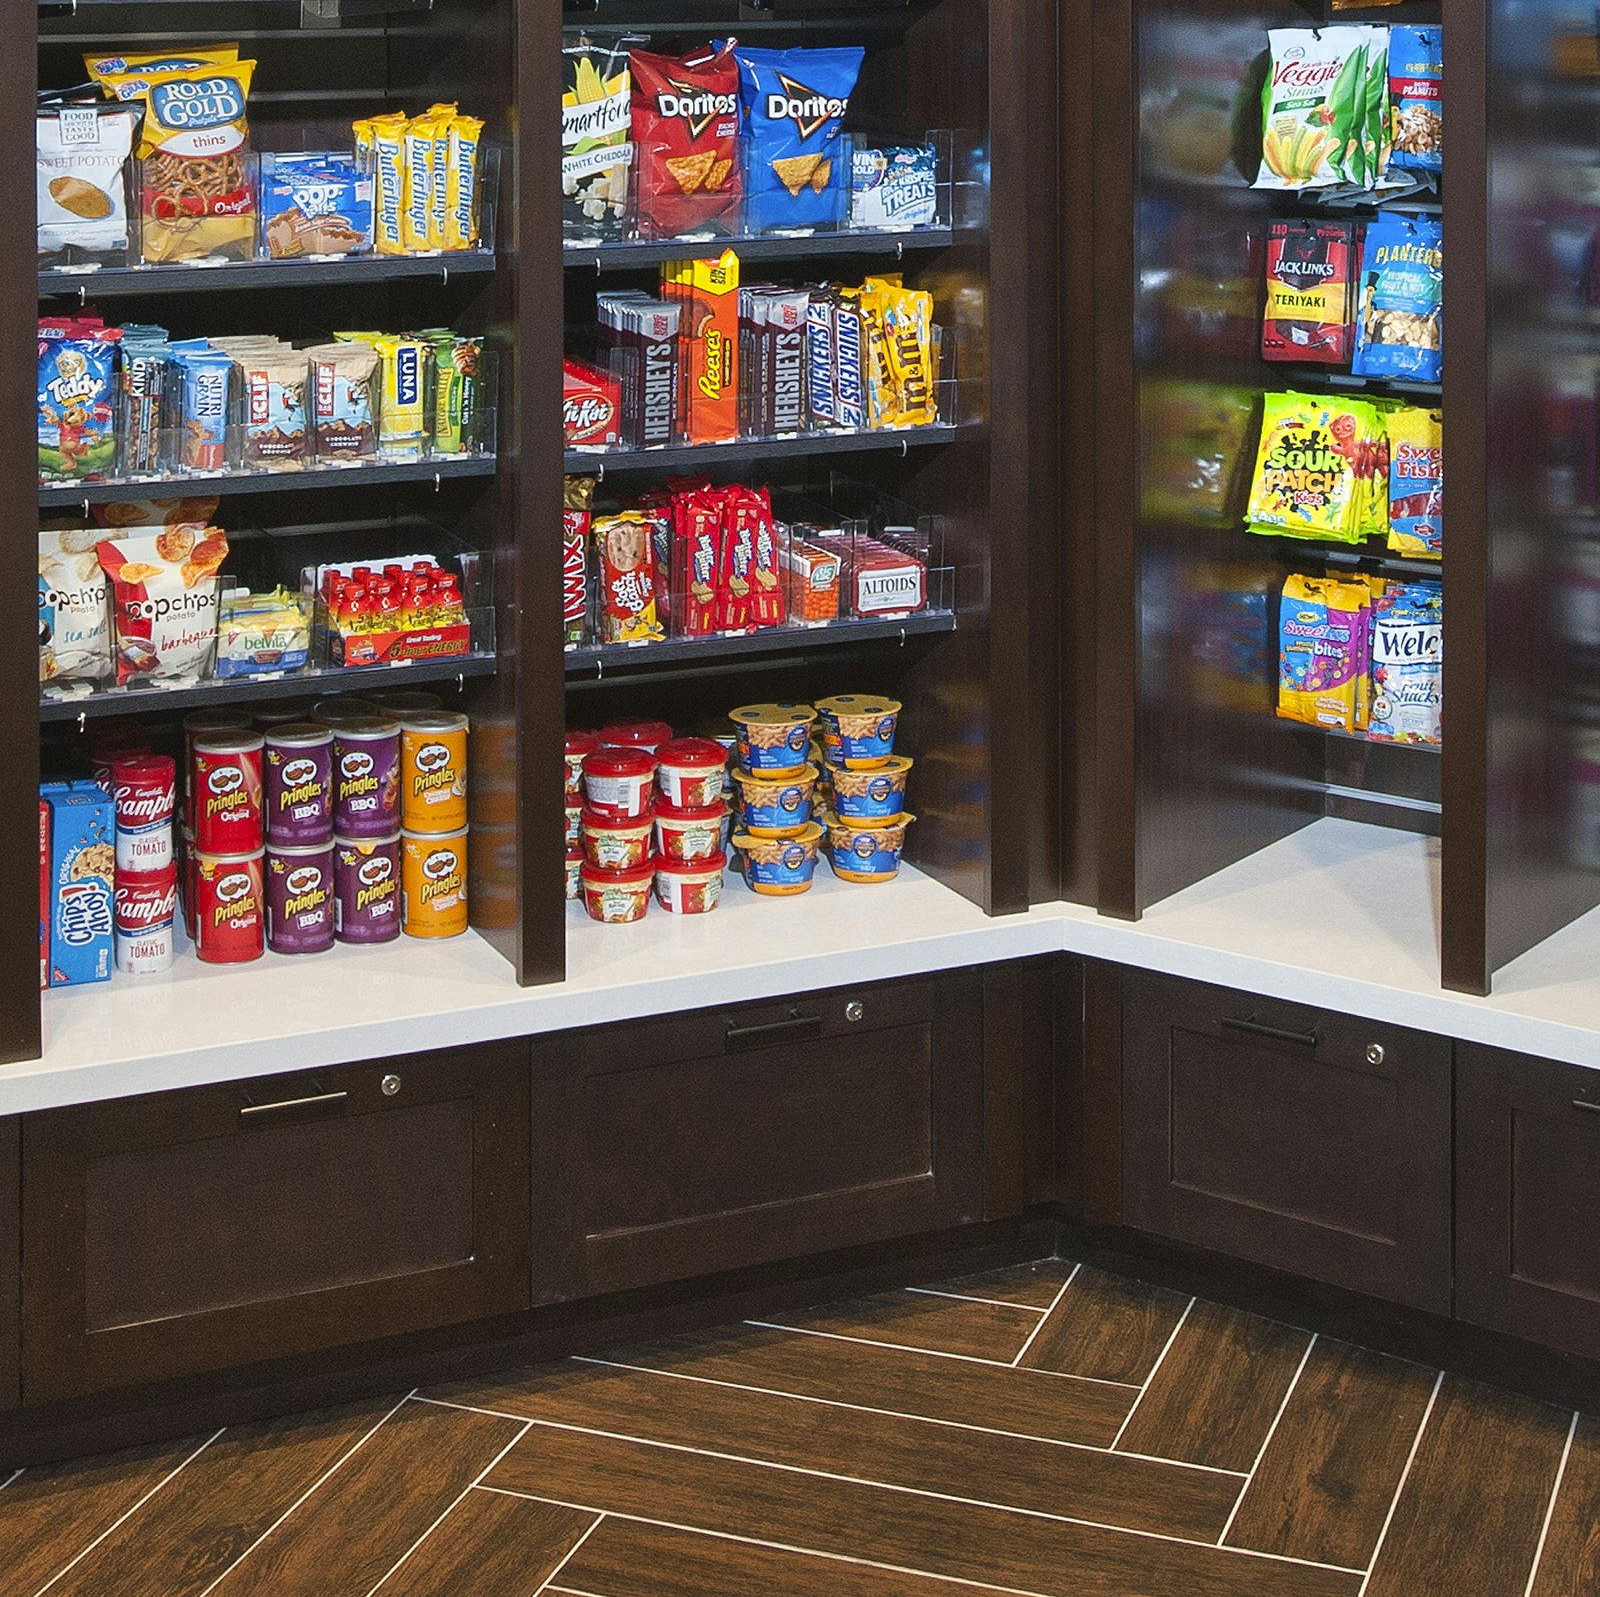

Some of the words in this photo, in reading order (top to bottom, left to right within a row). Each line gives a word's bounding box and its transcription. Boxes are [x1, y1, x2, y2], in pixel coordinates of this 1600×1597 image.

[1272, 59, 1344, 88] Veggie
[163, 79, 228, 101] ROLD
[64, 112, 93, 121] FOOD
[162, 95, 238, 125] GOLD
[658, 93, 737, 118] Doritos
[767, 94, 849, 118] Doritos
[1285, 99, 1302, 109] Sea
[1302, 98, 1317, 108] Salt
[65, 132, 95, 141] GOOD
[192, 135, 226, 148] thins
[39, 156, 75, 169] SWEET
[562, 157, 593, 174] WHITE
[594, 148, 631, 165] CHEDDAR
[377, 140, 399, 244] Butterfinger
[409, 137, 432, 239] Butterfinger
[453, 137, 475, 239] Butterfinger
[882, 183, 936, 217] TREATS
[1273, 260, 1301, 276] JACK
[1376, 245, 1443, 267] PLANTERS
[1275, 294, 1326, 308] TERIYAKI
[697, 328, 723, 401] Reese's
[809, 324, 834, 417] SNICKERS
[838, 312, 860, 405] SNICKERS
[47, 370, 104, 404] Teddy
[131, 361, 146, 397] KIND
[318, 366, 333, 405] CLIF
[401, 352, 415, 401] LUNA
[774, 332, 800, 433] HERSHEY'S
[197, 373, 210, 417] GRAIN
[210, 372, 224, 417] NUTRI
[252, 374, 267, 413] CLIF
[644, 343, 671, 440] HERSHEY'S
[1270, 448, 1342, 472] SOUR
[1266, 469, 1342, 493] PATCH
[862, 576, 917, 596] ALTOIDS
[38, 587, 106, 612] popchip
[126, 592, 216, 622] popchips
[166, 611, 196, 623] potato
[63, 629, 83, 644] sea
[87, 620, 108, 639] salt
[1380, 630, 1438, 655] Welc
[1314, 642, 1344, 658] bites
[339, 775, 379, 801] Pringles
[414, 767, 455, 797] Pringles
[206, 789, 248, 818] Pringles
[280, 781, 322, 810] Pringles
[350, 797, 378, 812] BBQ
[293, 802, 320, 821] BBQ
[131, 841, 166, 856] TOMATO
[357, 882, 395, 911] Pringles
[421, 874, 461, 903] Pringles
[214, 895, 255, 928] Pringles
[284, 888, 326, 920] Pringles
[371, 901, 394, 918] BBQ
[299, 911, 324, 927] BBQ
[130, 944, 165, 959] TOMATO
